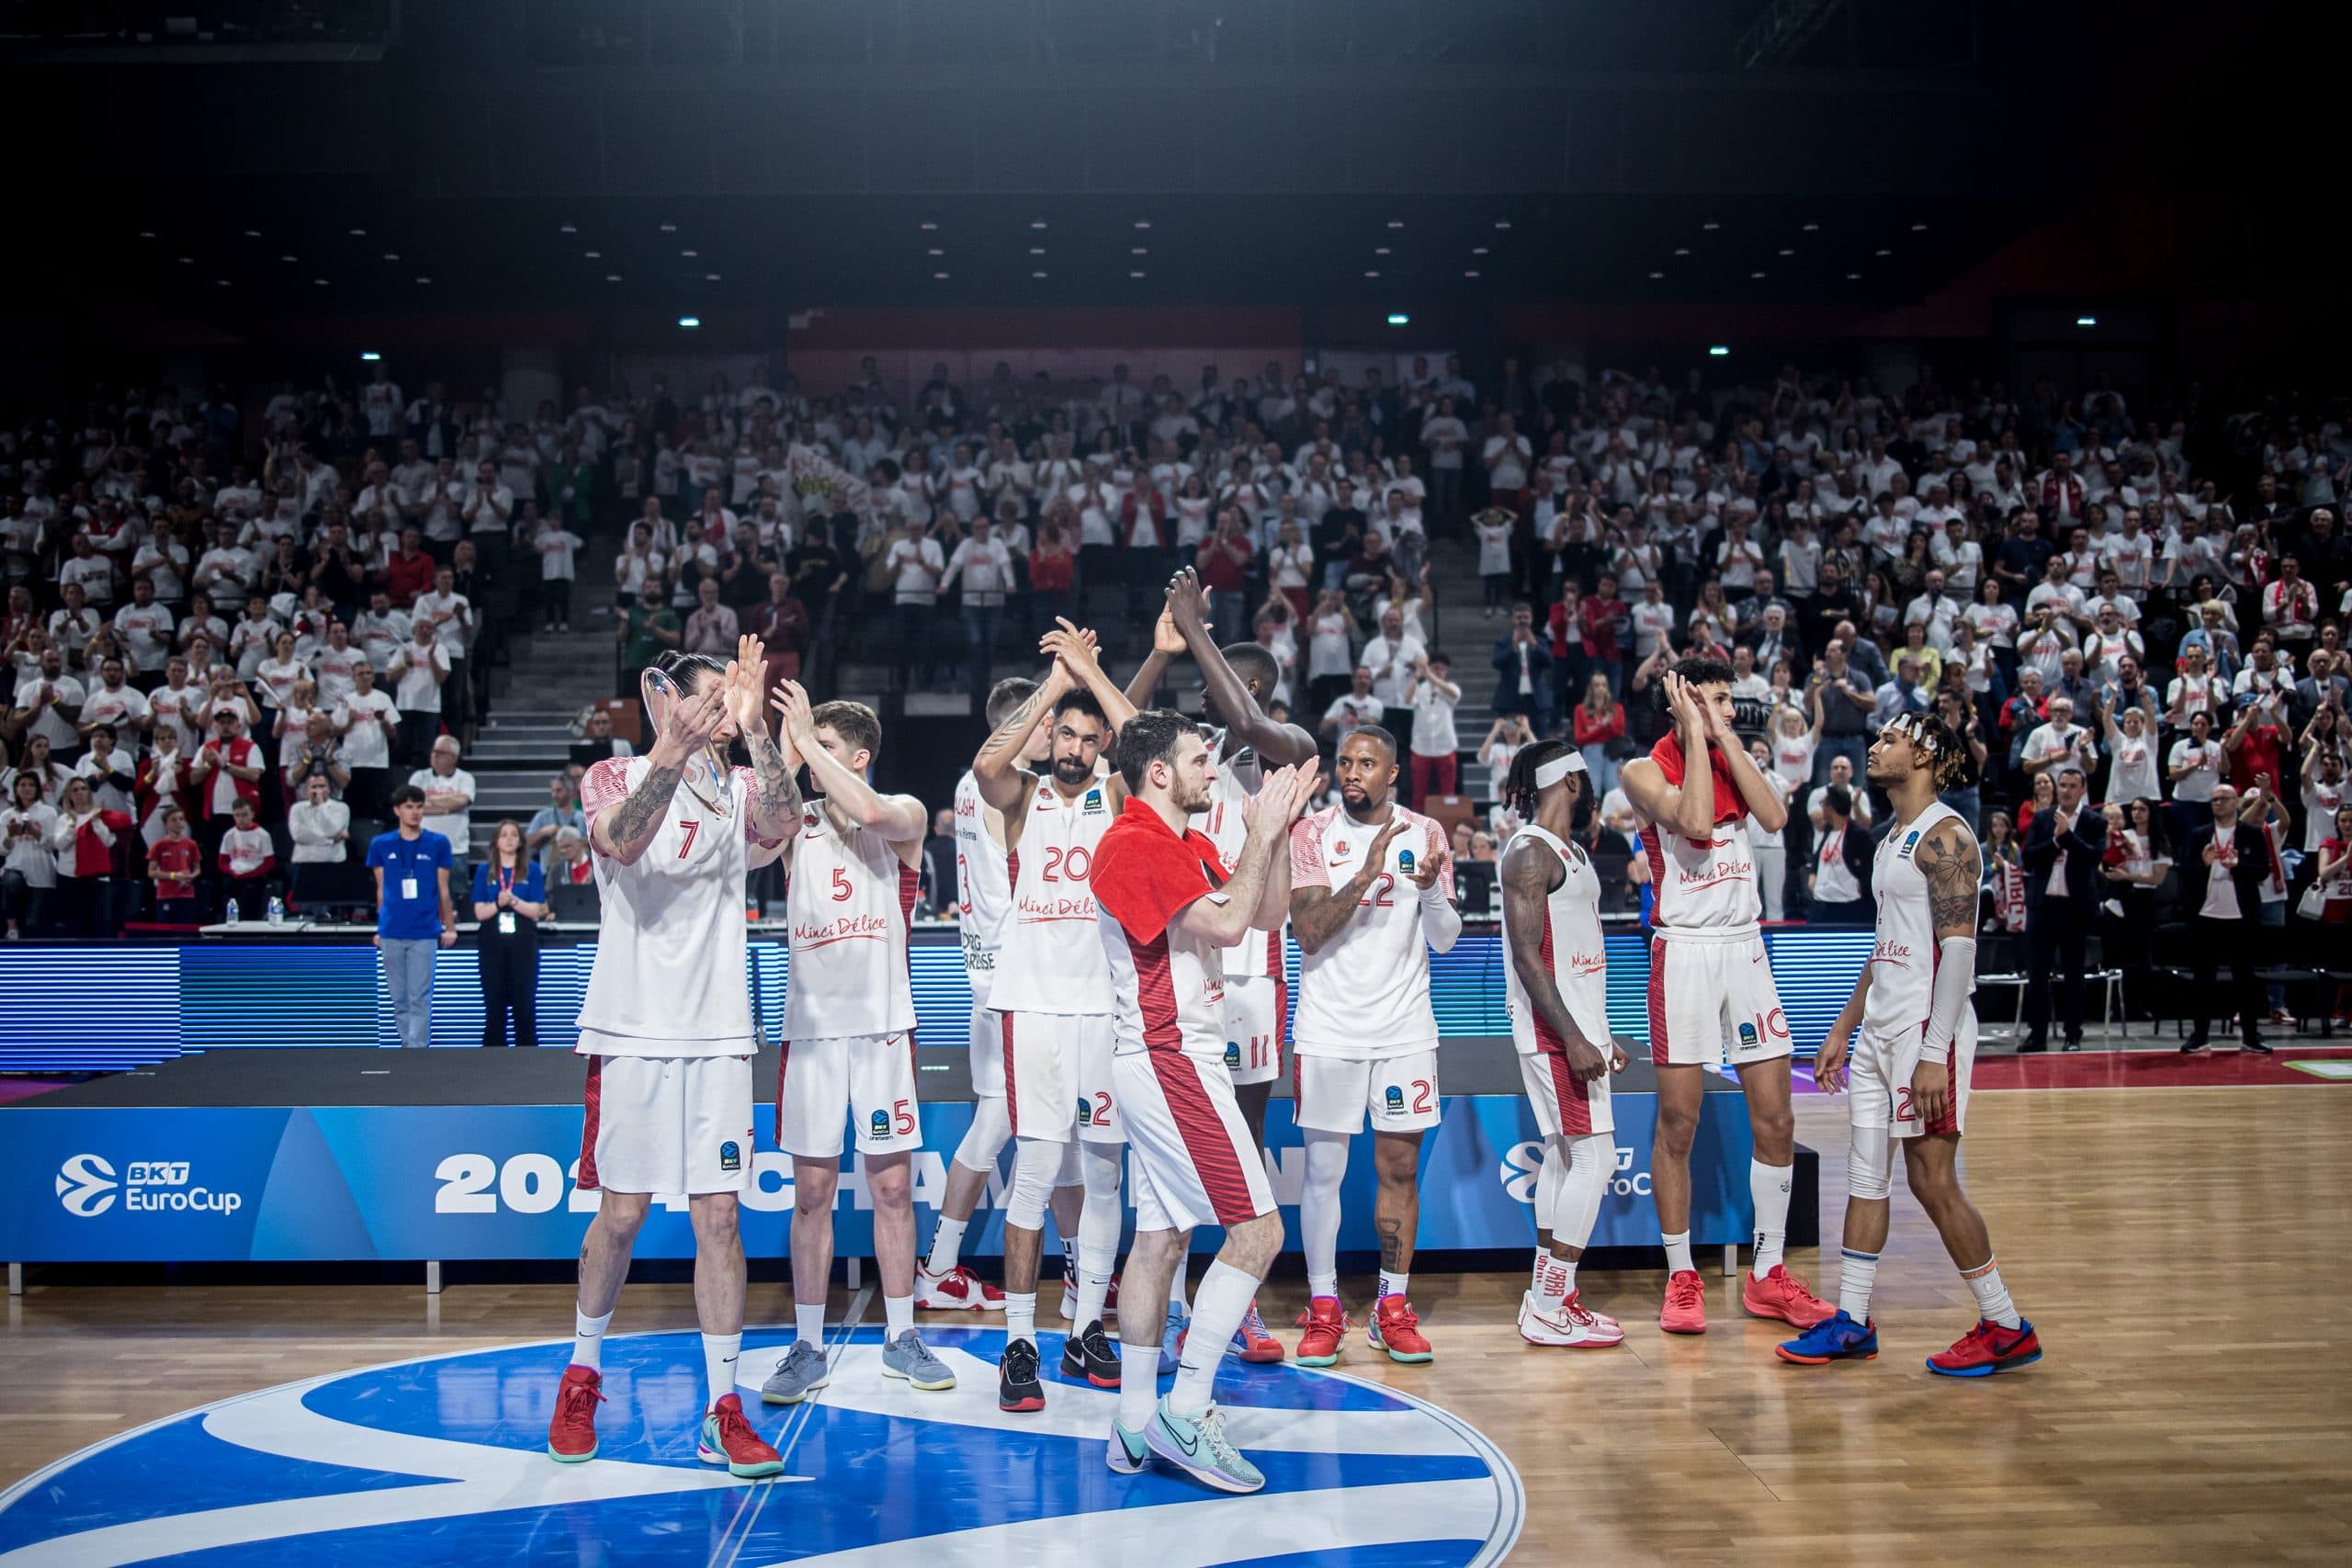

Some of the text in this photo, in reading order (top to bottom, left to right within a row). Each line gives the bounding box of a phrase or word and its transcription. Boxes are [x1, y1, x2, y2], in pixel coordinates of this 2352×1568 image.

[678, 819, 700, 860] 7
[1043, 846, 1091, 882] 20
[831, 867, 853, 902] 5
[1019, 895, 1096, 915] Minci Déli
[794, 914, 888, 942] Minci Délice
[1250, 1034, 1269, 1069] 11
[894, 1099, 915, 1135] 5
[128, 1164, 189, 1184] BKT
[126, 1187, 242, 1216] EuroCup
